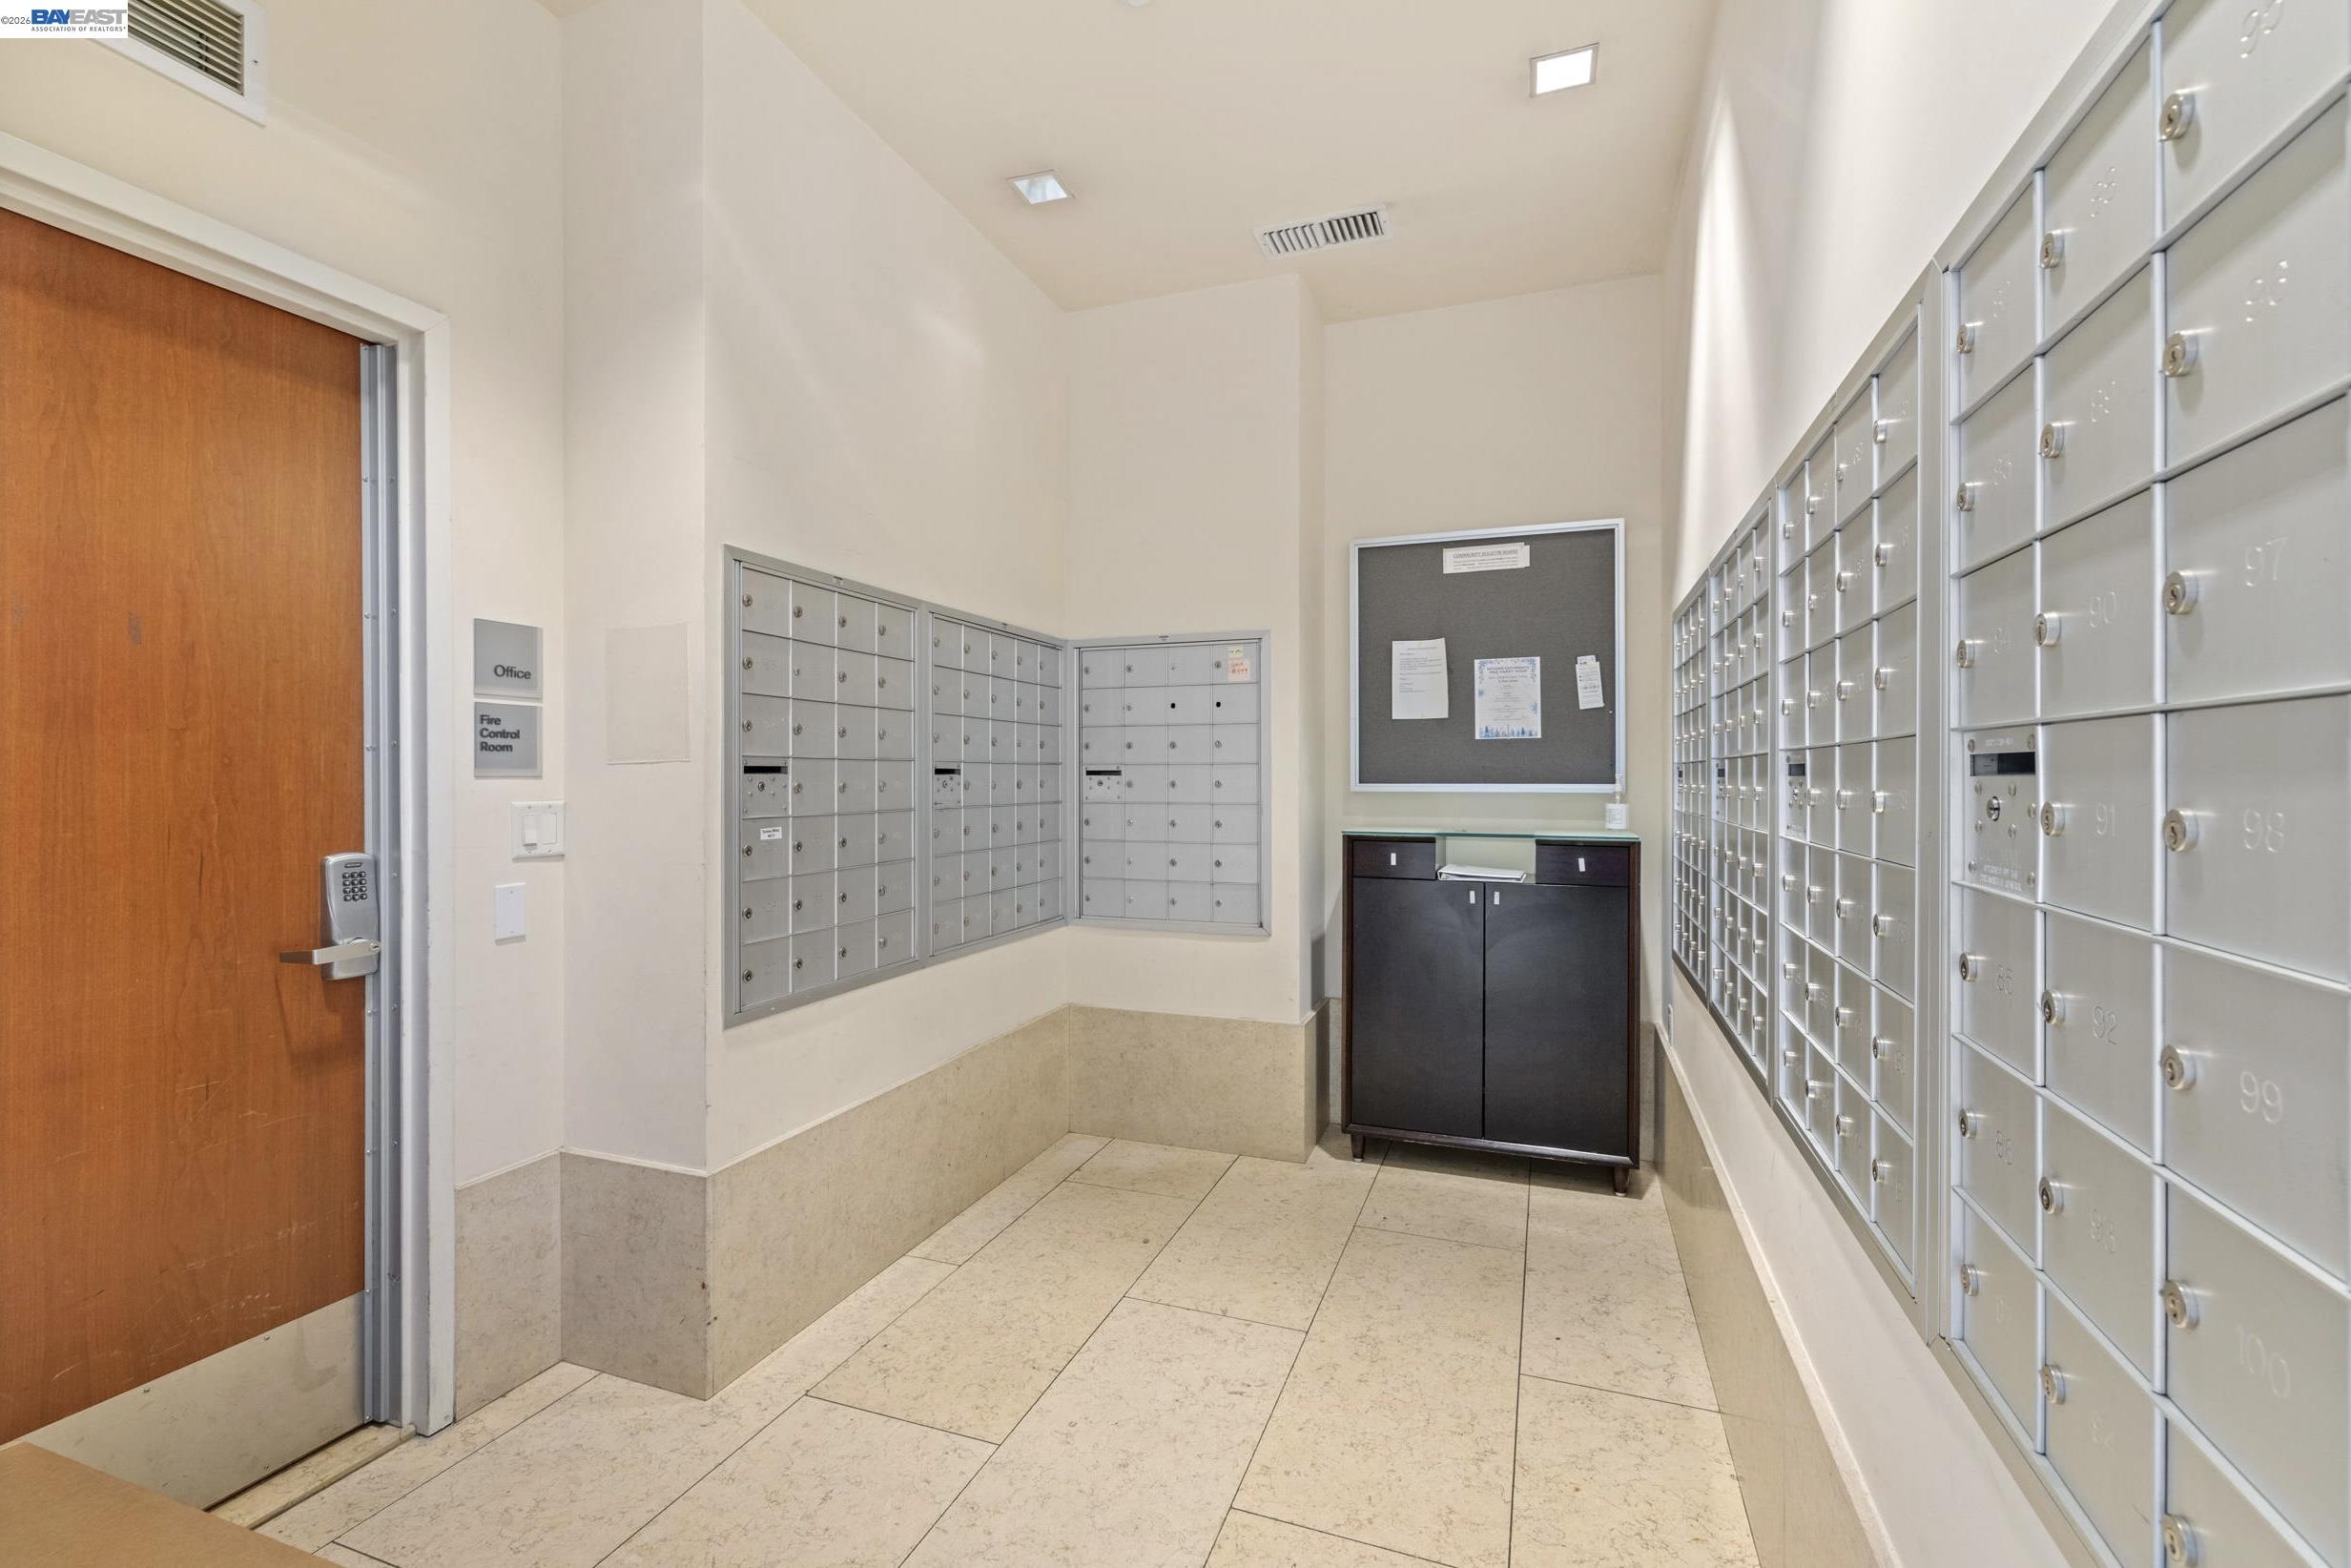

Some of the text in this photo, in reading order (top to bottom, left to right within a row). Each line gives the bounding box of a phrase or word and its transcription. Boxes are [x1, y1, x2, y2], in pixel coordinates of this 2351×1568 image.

[2244, 535, 2290, 587] 97
[2089, 590, 2117, 629] 90
[493, 664, 531, 679] Office
[479, 728, 521, 739] Control
[480, 714, 502, 725] Fire
[480, 741, 513, 752] Room
[2095, 802, 2115, 836] 91
[2243, 808, 2285, 853] 98
[2092, 1004, 2118, 1046] 92
[2239, 1070, 2284, 1124] 99
[2236, 1322, 2292, 1400] 100
